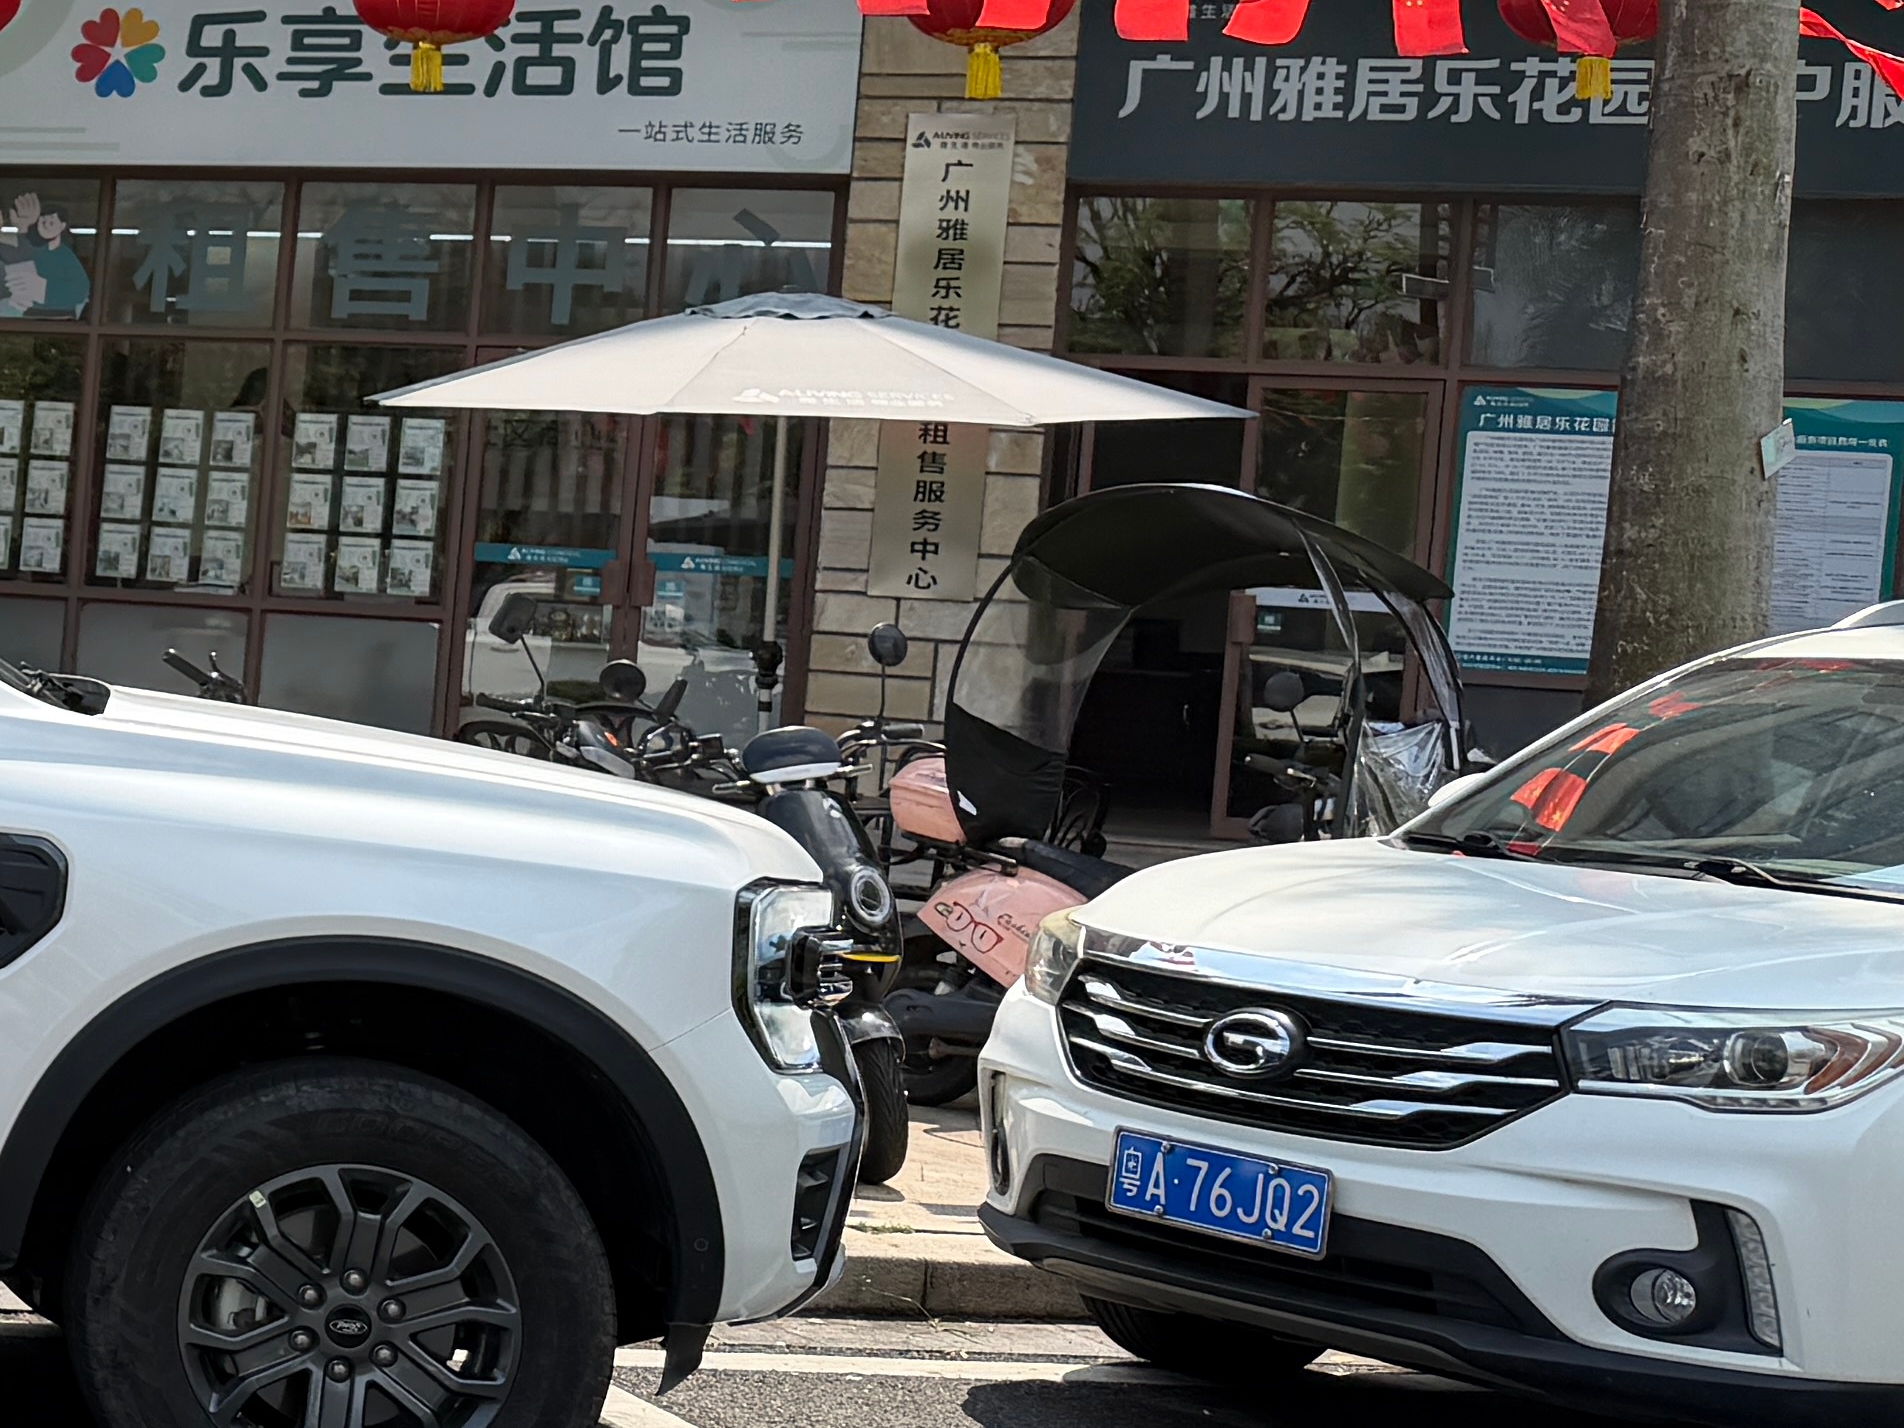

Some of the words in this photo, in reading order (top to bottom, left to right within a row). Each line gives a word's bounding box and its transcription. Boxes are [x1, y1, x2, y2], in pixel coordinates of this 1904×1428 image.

[617, 120, 805, 147] 一站式生活服务
